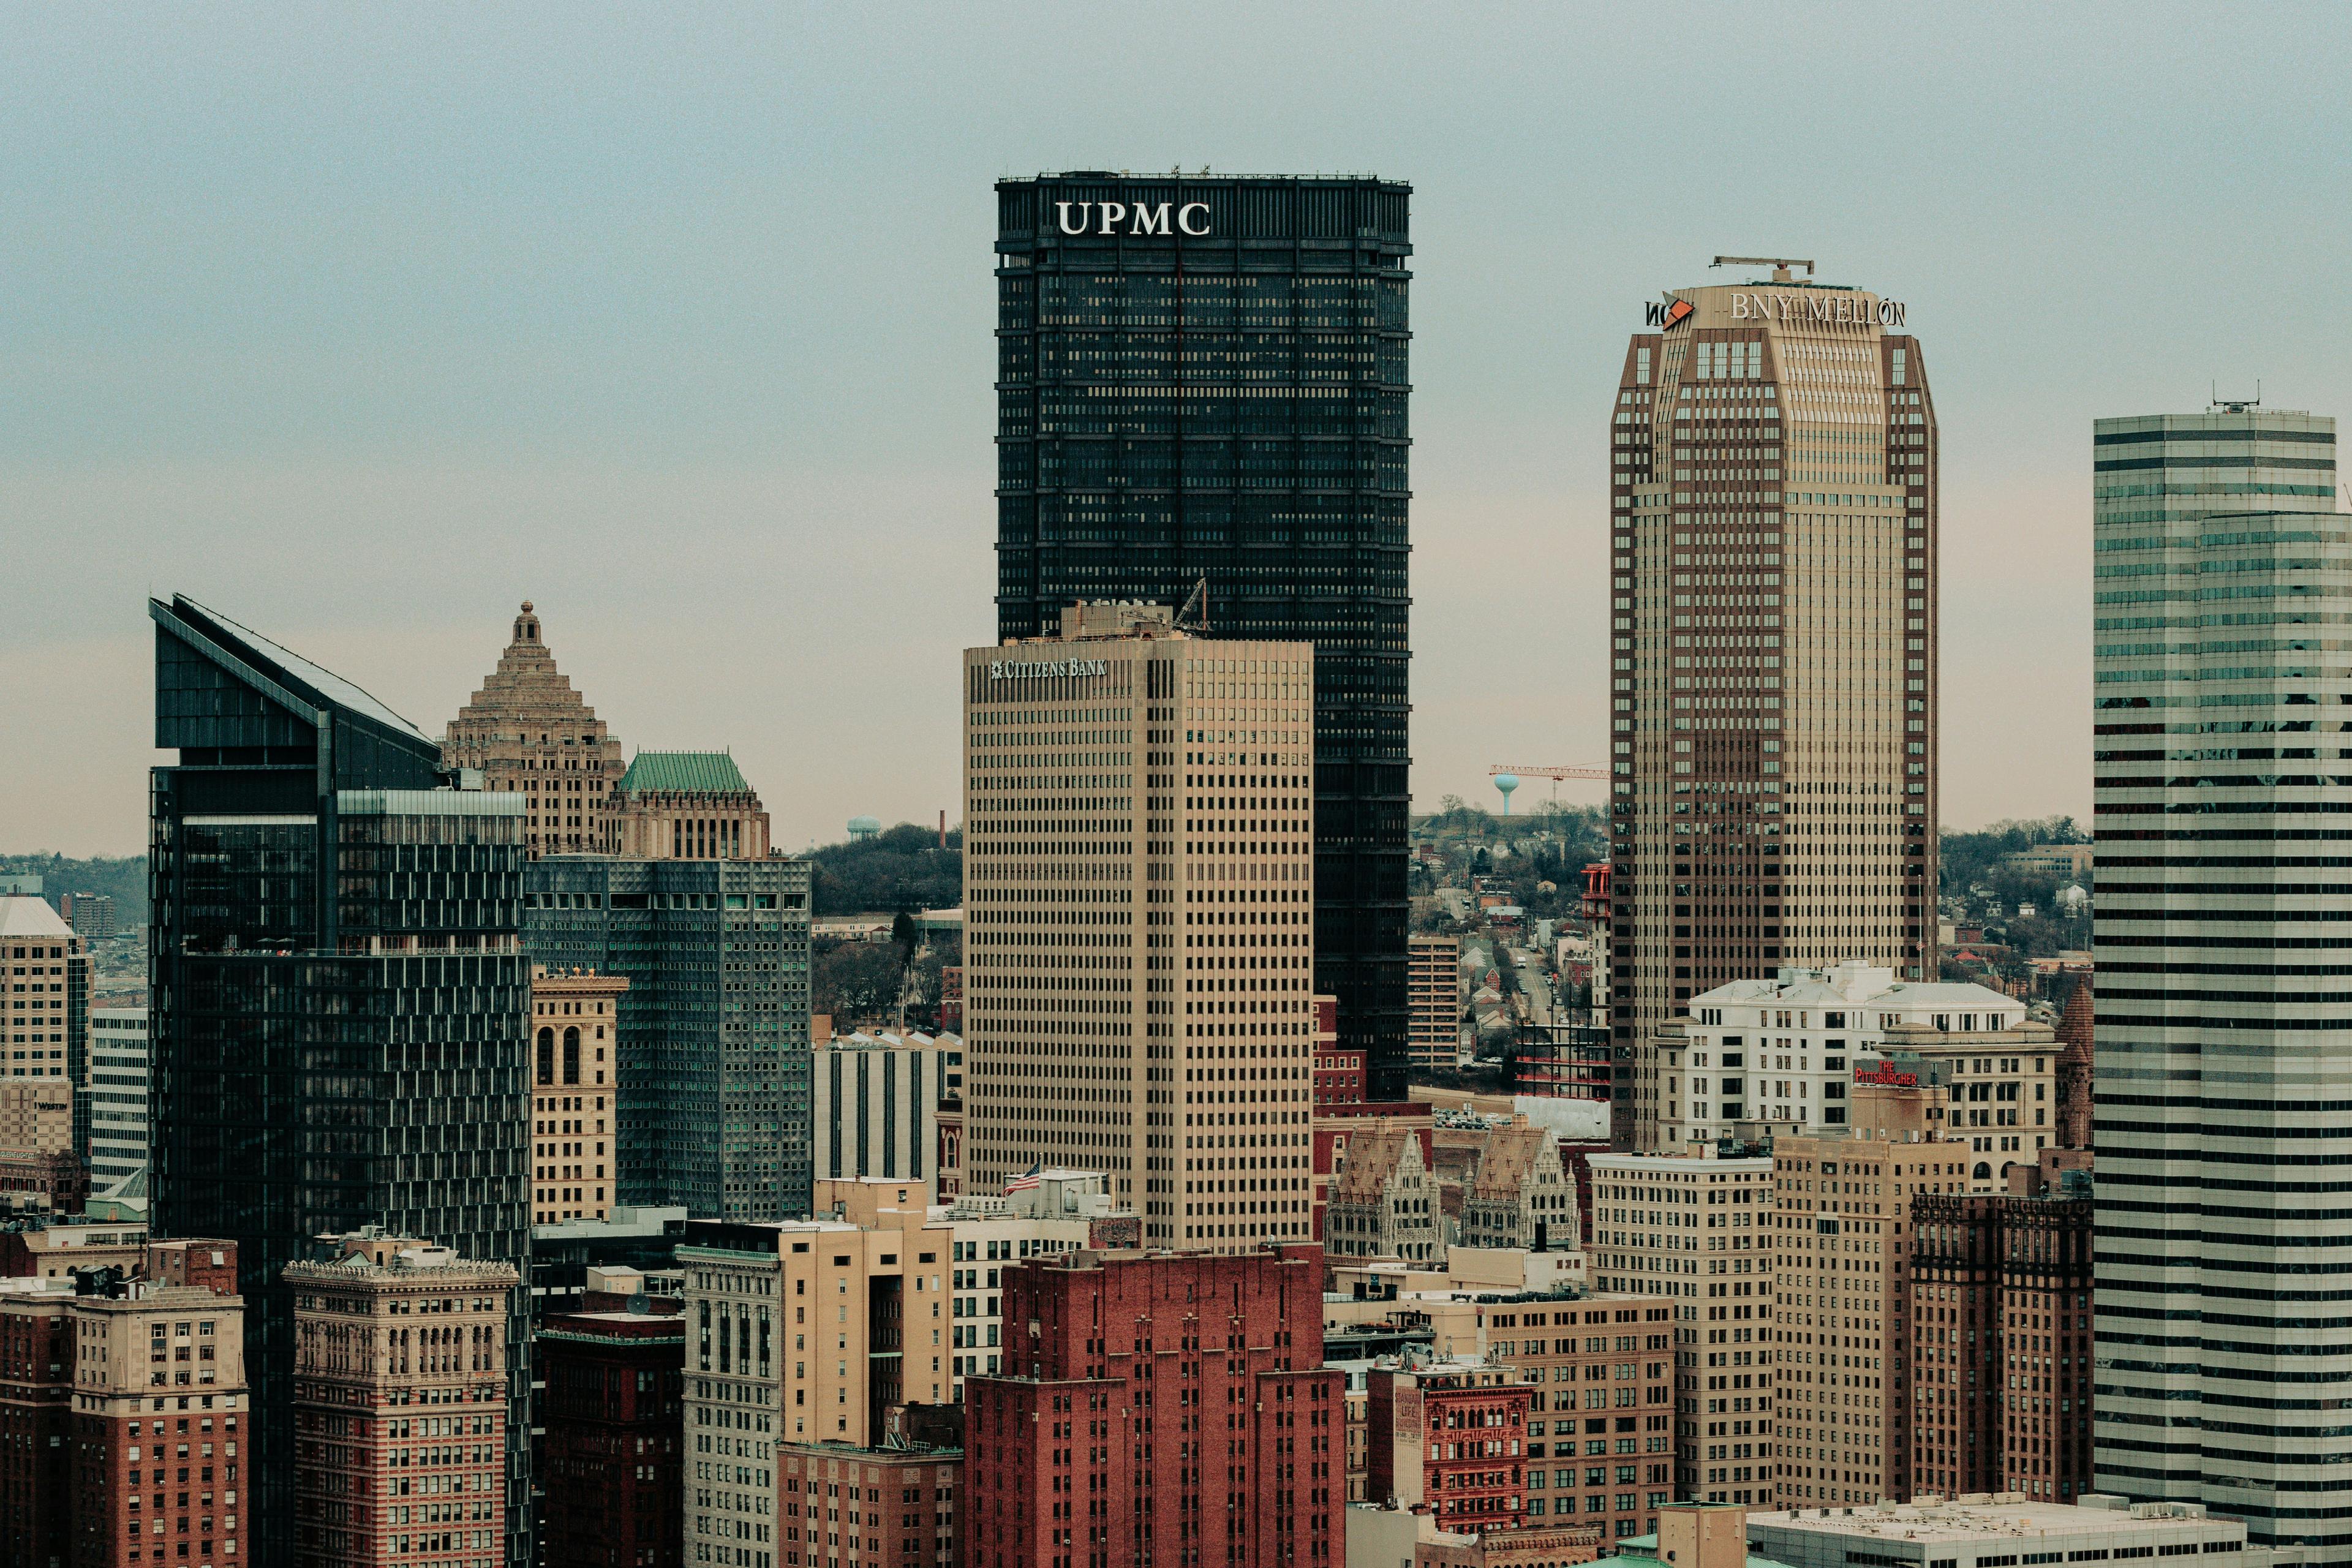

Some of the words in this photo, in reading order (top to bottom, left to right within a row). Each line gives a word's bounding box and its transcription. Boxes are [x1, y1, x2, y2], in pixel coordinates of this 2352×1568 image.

[1055, 202, 1210, 235] UPMC
[1730, 293, 1794, 320] BNY
[1806, 295, 1907, 327] MELLON
[1005, 660, 1066, 679] CITIZENS
[1069, 657, 1107, 676] BANK
[1879, 1060, 1894, 1072] THE
[1855, 1068, 1917, 1085] PITTSBURGHER
[37, 1102, 67, 1110] WESTIN
